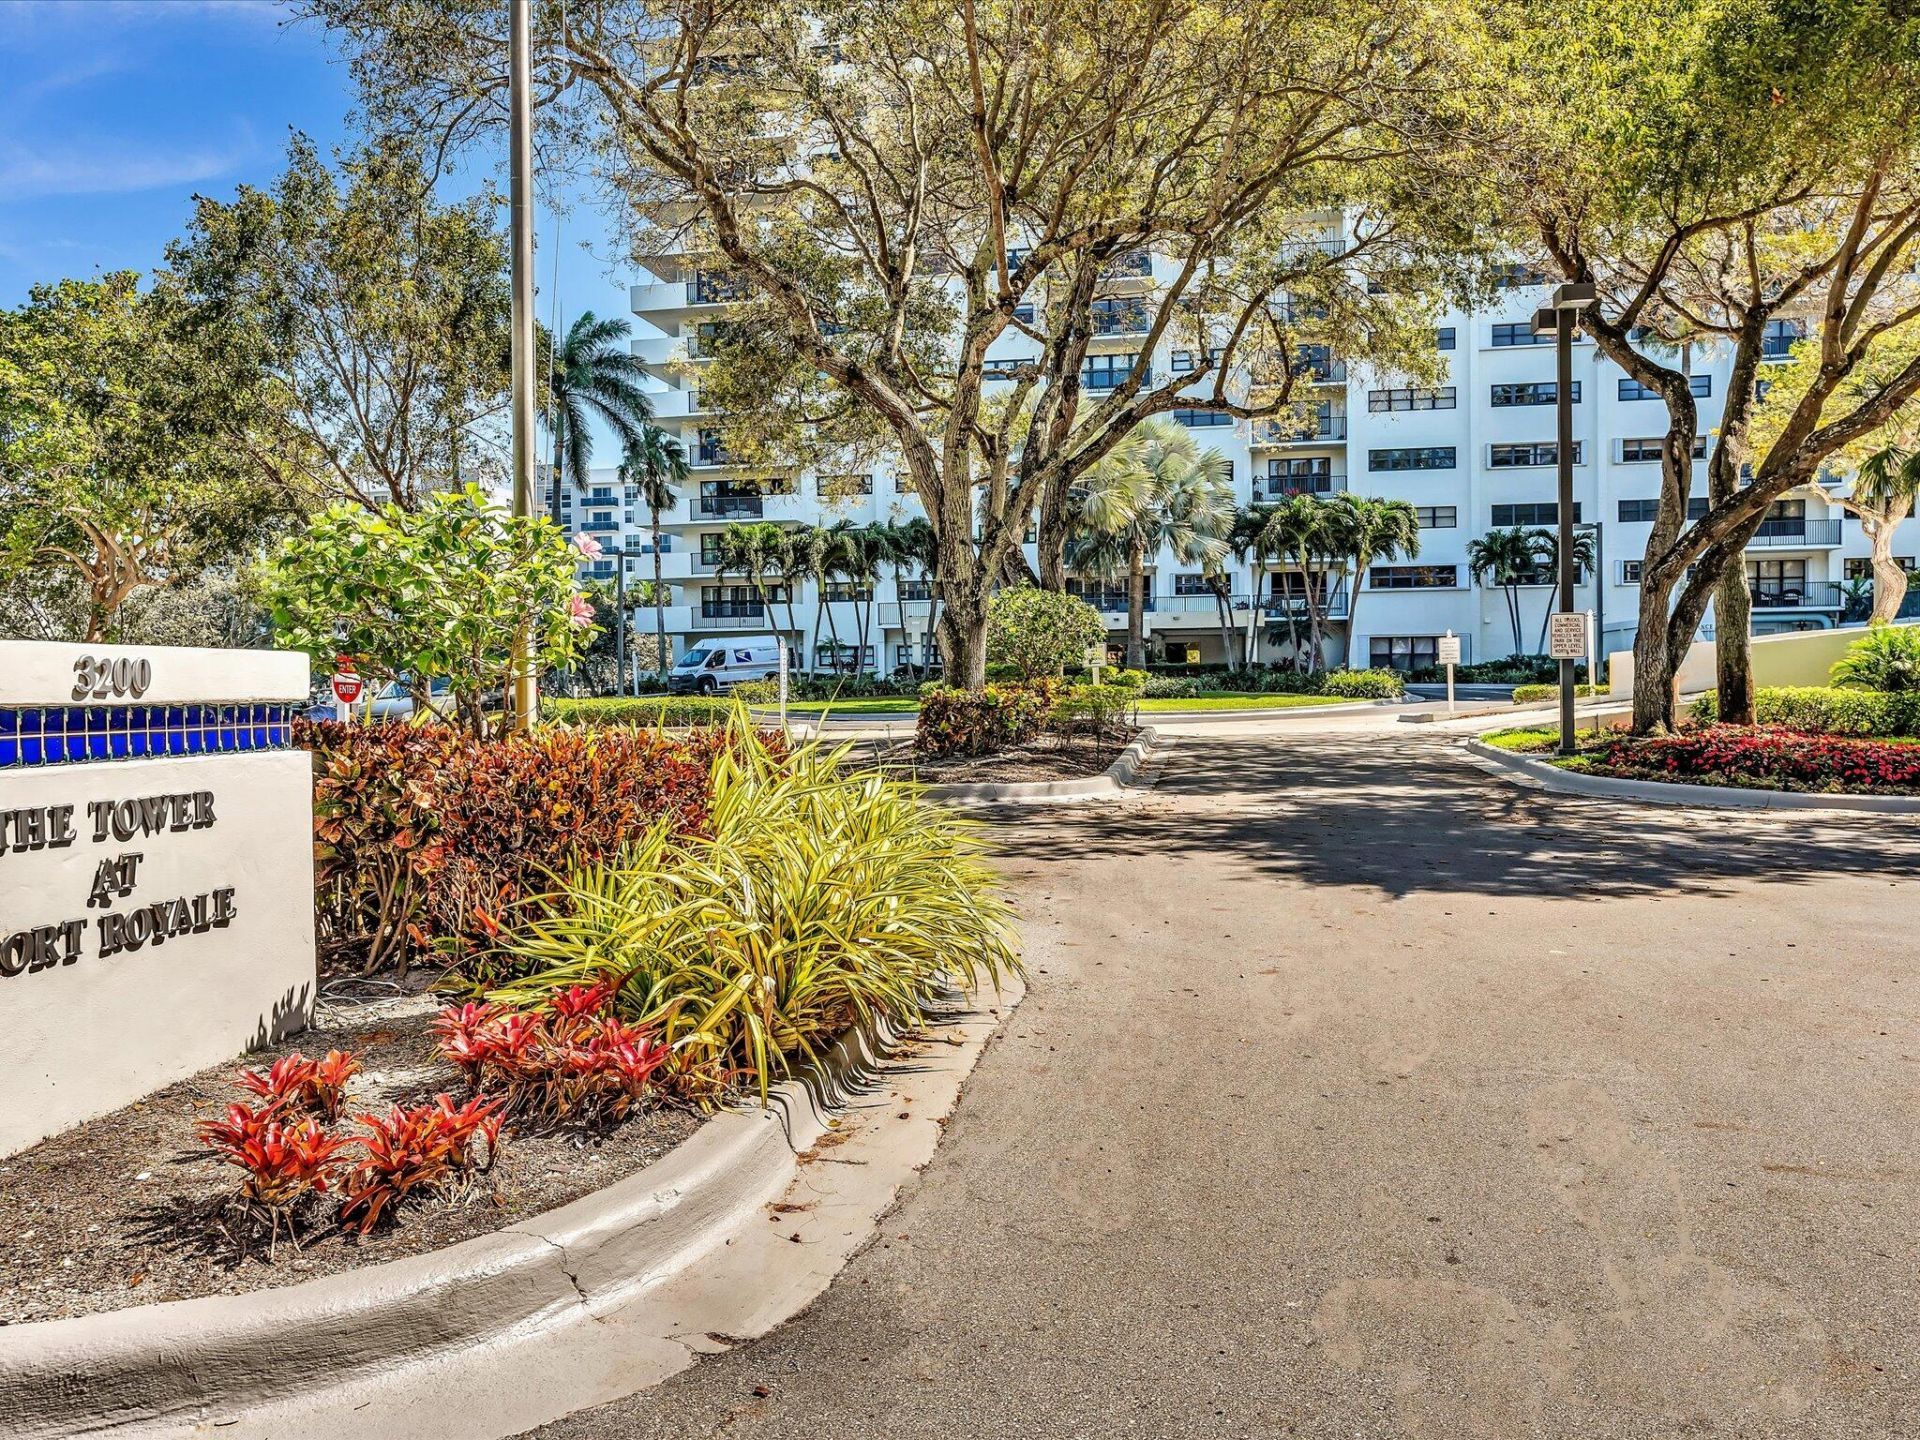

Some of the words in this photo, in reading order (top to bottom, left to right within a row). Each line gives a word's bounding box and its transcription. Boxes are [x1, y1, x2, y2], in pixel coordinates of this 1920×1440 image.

[73, 655, 152, 698] 3200
[339, 684, 356, 694] ENTER
[88, 791, 217, 840] TOWER
[89, 852, 143, 906] AT
[0, 918, 88, 976] ORT
[98, 886, 237, 956] ROYALE
